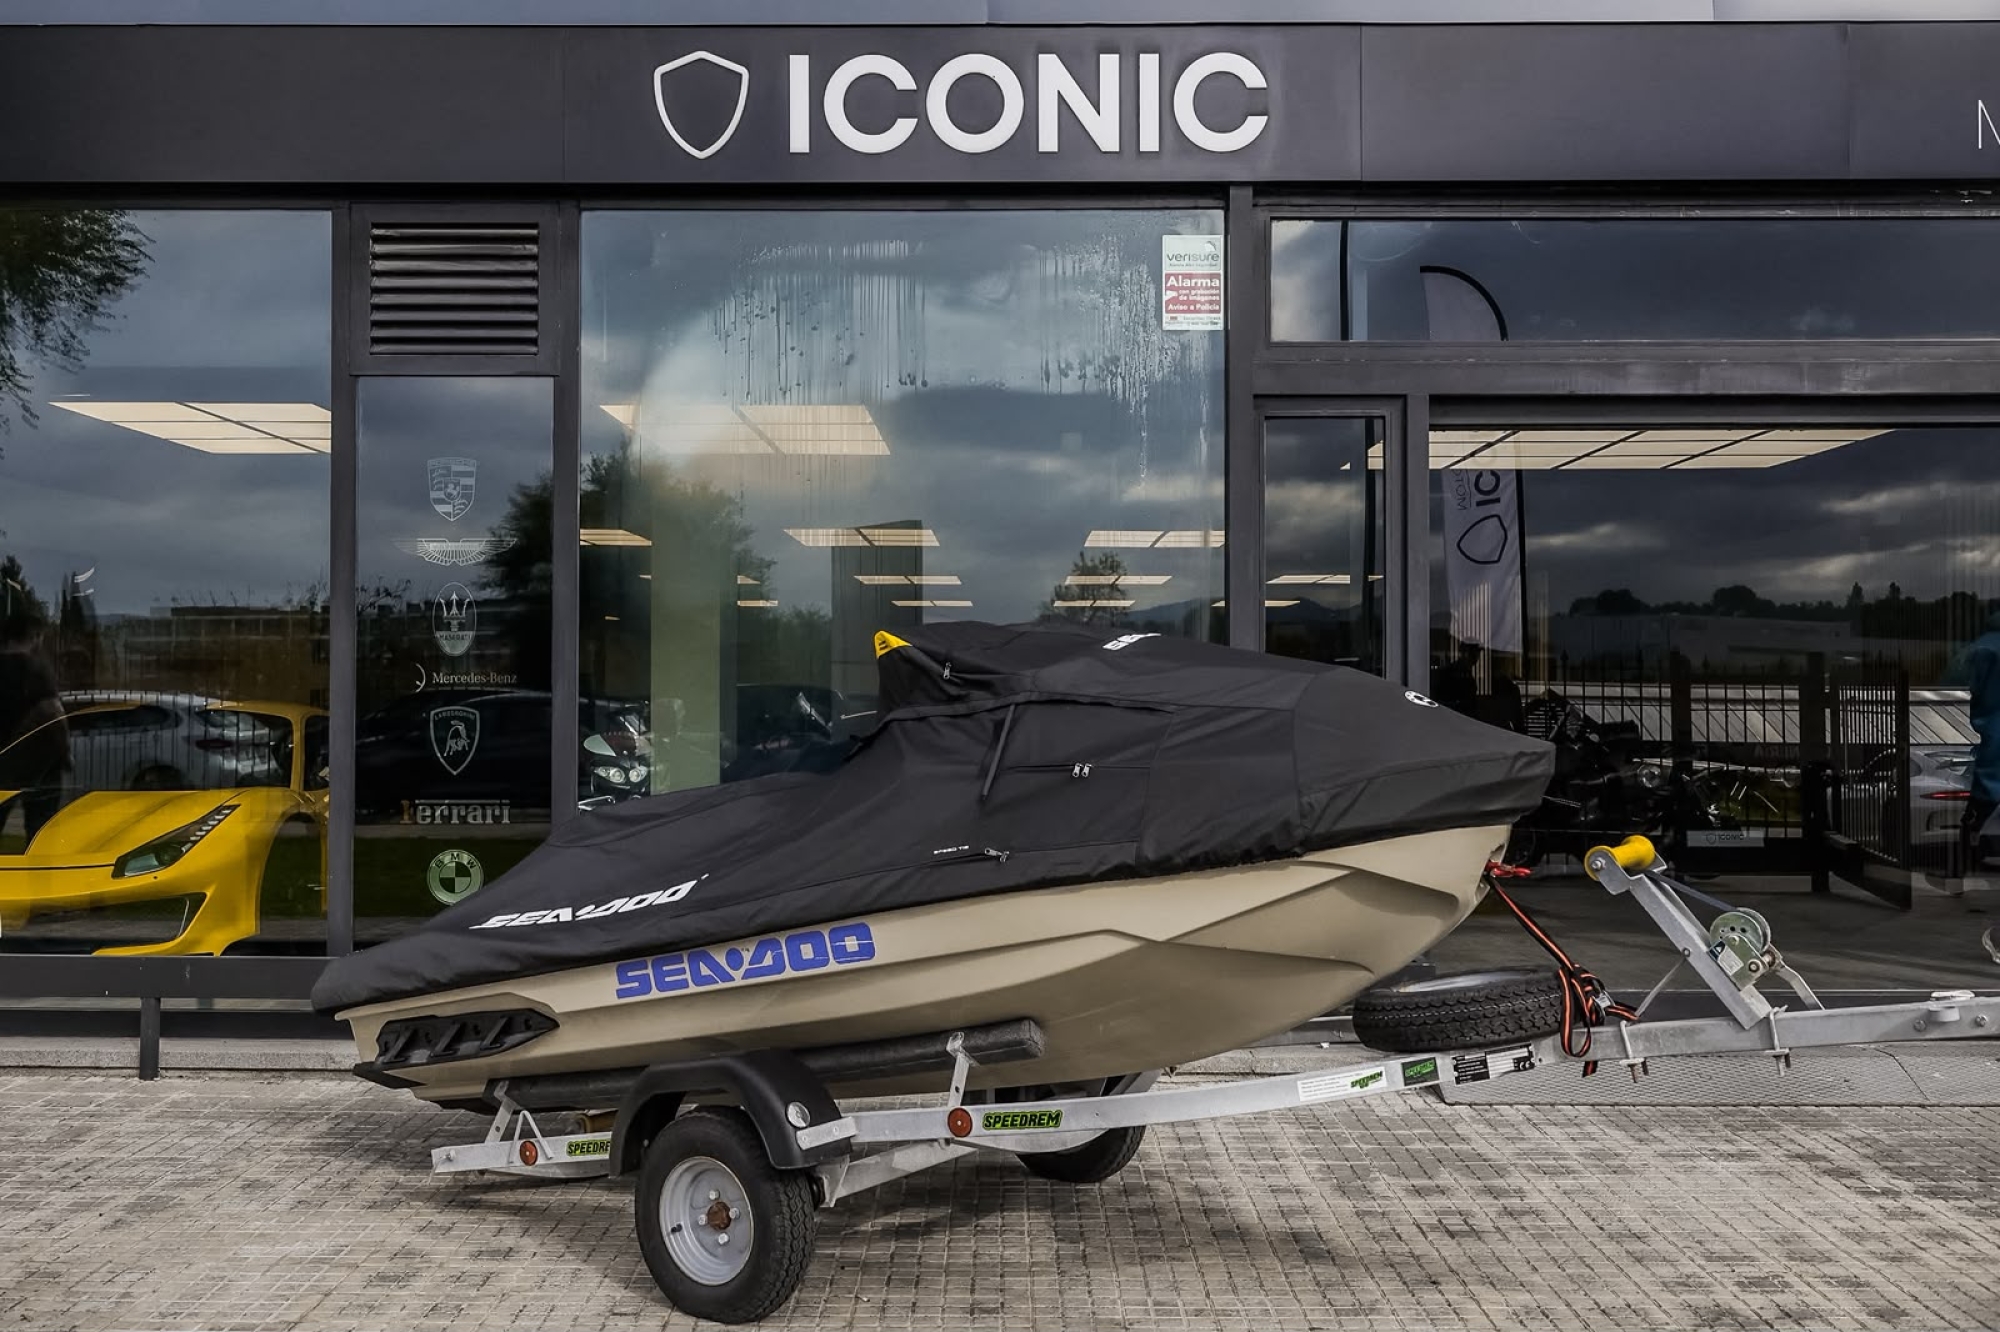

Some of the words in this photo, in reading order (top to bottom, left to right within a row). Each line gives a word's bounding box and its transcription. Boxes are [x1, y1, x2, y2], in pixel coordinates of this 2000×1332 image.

[789, 52, 1269, 154] ICONIC
[1166, 252, 1220, 262] verisure
[1166, 275, 1220, 287] Alarma
[432, 672, 517, 684] Mercedes-Benz
[434, 852, 477, 870] BMW
[984, 1112, 1062, 1128] SPEEDREM
